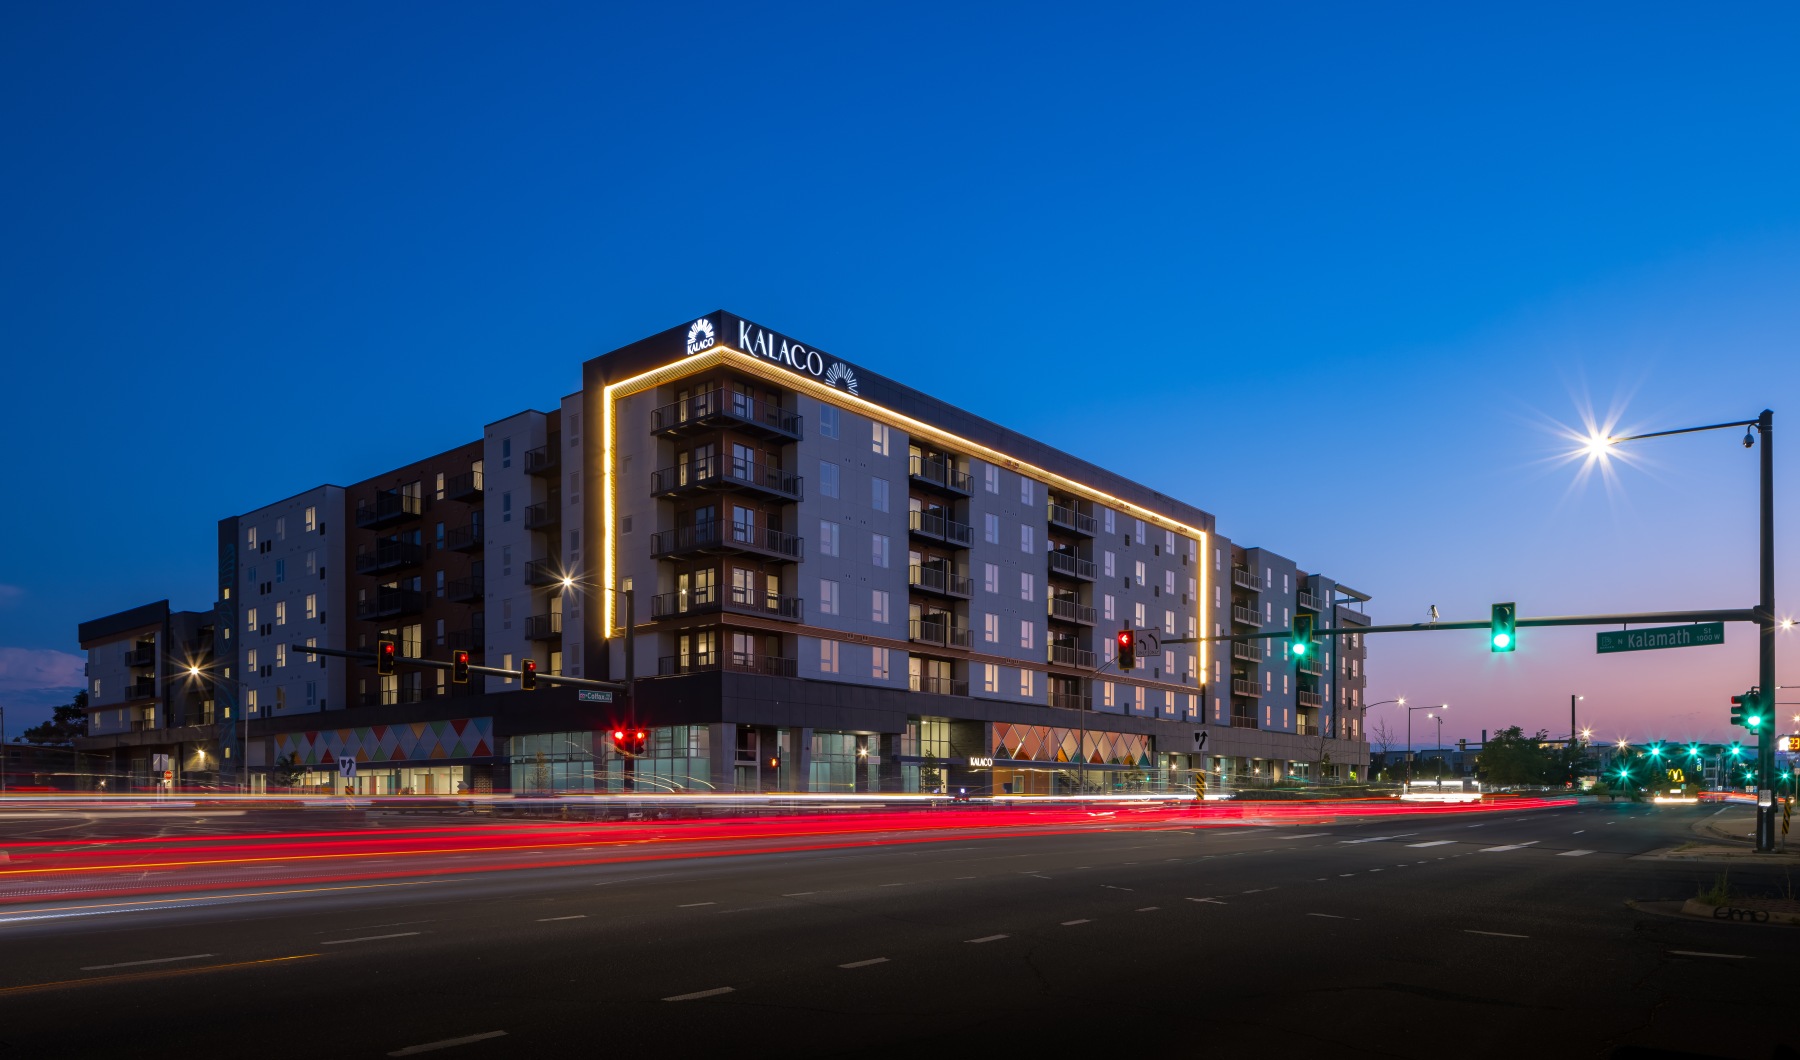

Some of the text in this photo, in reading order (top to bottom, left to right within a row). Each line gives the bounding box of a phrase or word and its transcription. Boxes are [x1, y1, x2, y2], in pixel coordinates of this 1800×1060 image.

[687, 337, 714, 355] KALACO
[739, 320, 823, 376] KALACO
[1628, 629, 1690, 648] Kalamath
[970, 757, 992, 766] KALACO
